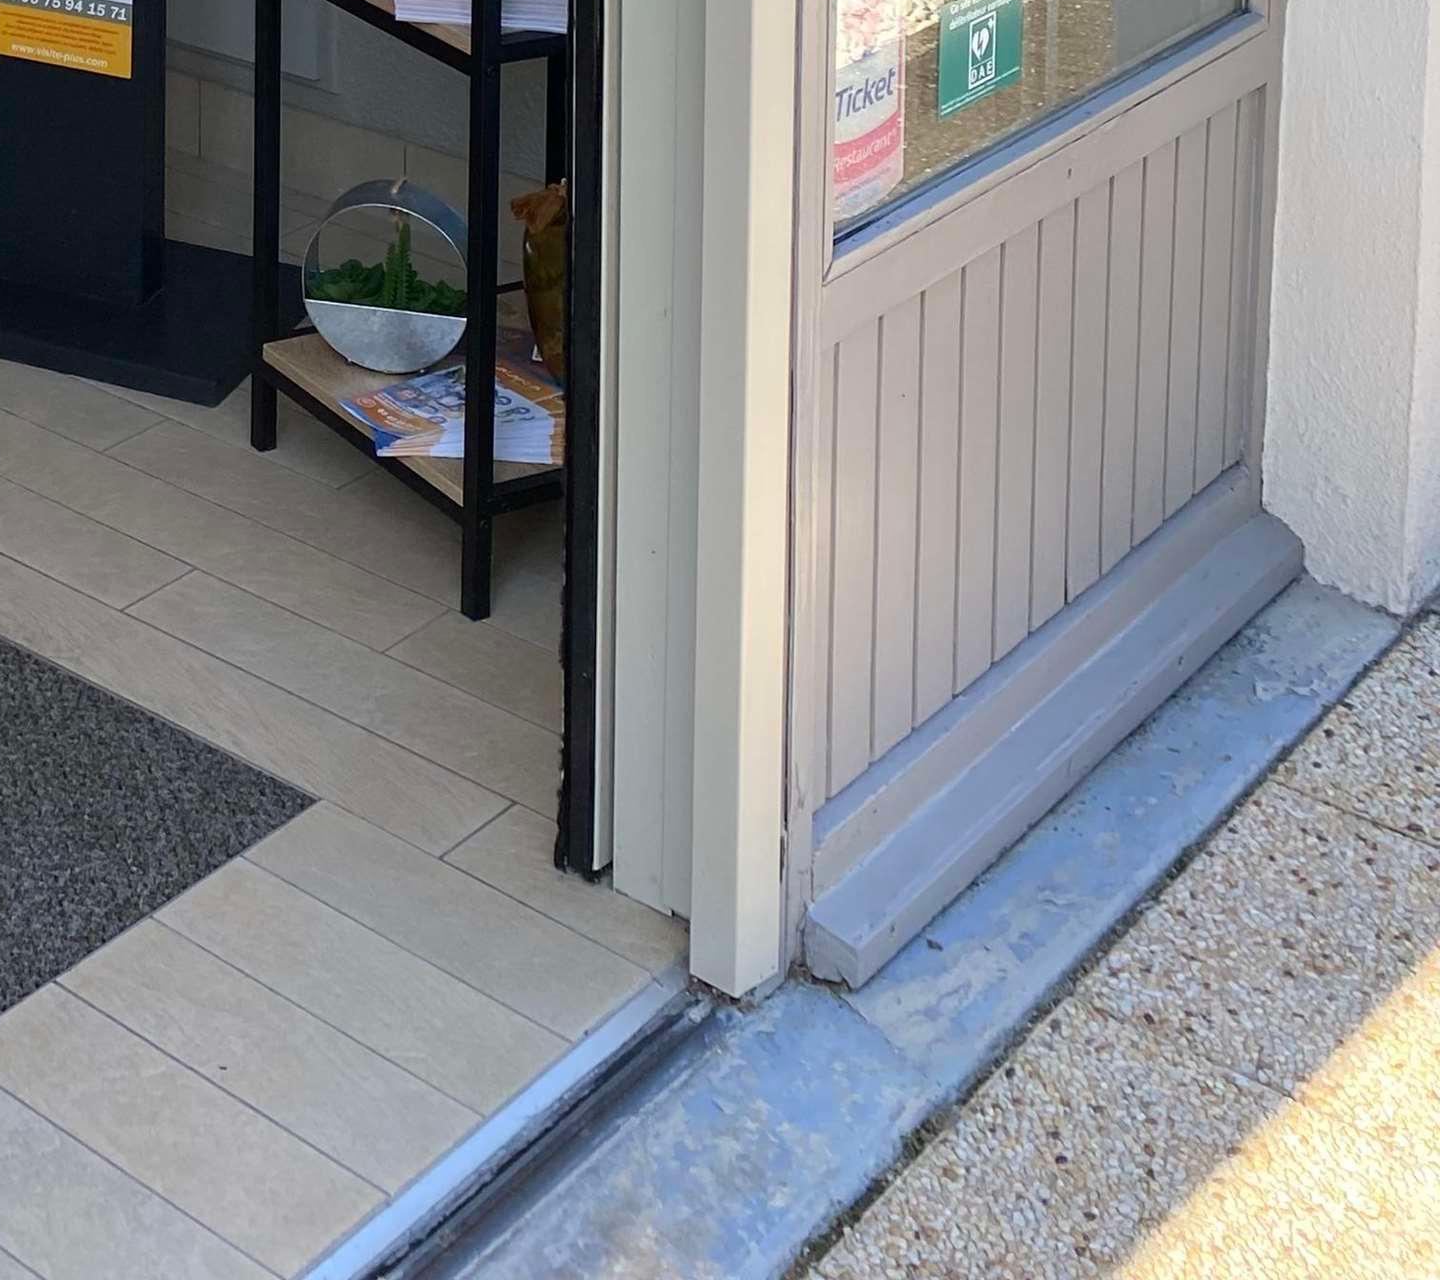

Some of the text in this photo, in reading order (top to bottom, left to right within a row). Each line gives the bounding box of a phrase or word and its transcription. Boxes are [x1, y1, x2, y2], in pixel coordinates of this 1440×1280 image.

[86, 2, 106, 18] 15
[110, 6, 127, 21] 71
[969, 61, 993, 85] DAE
[835, 66, 897, 123] Ticket
